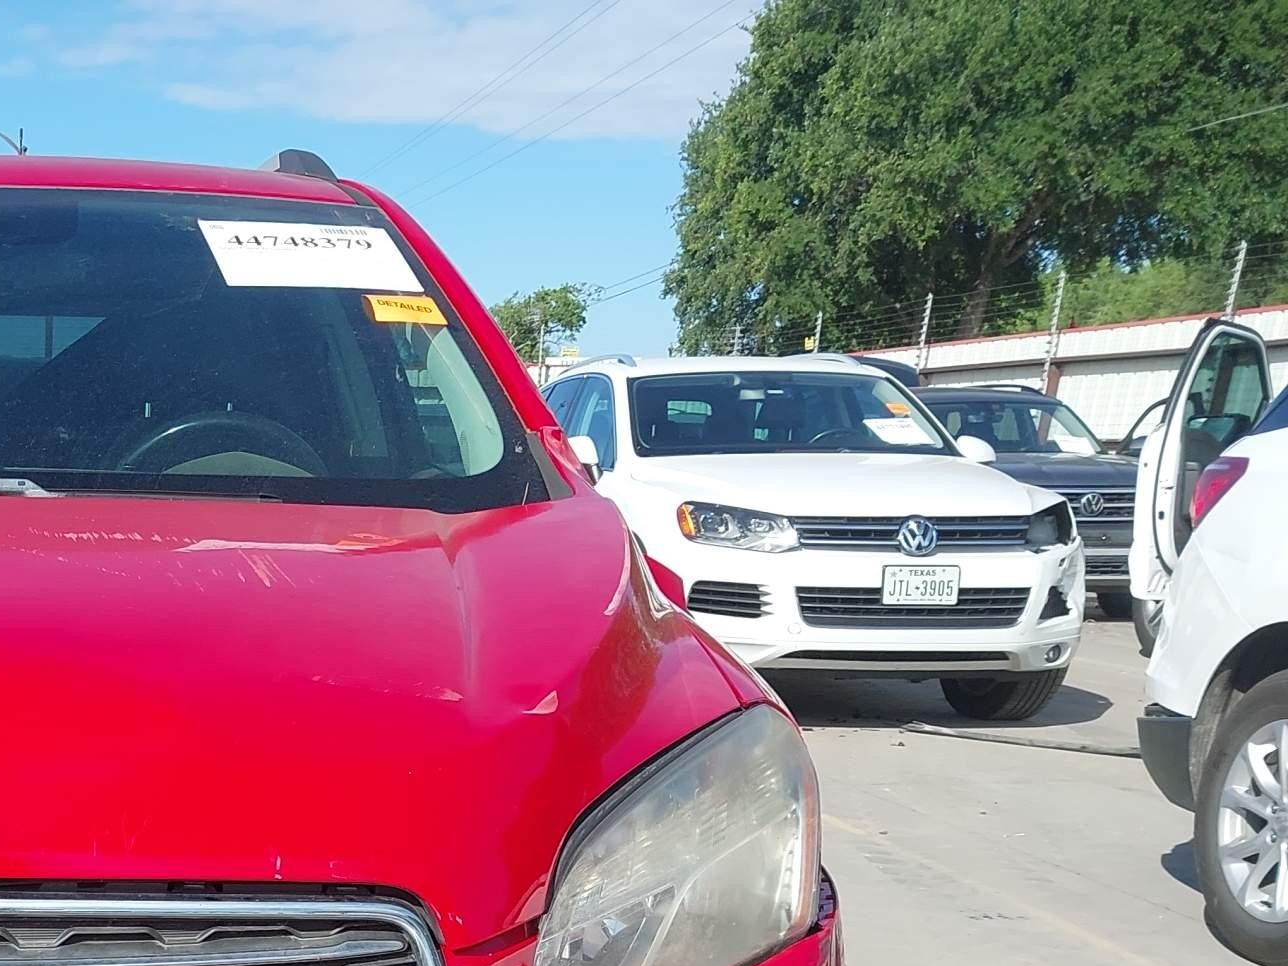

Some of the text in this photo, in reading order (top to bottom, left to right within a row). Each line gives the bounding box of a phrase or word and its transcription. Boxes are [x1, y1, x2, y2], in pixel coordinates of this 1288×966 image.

[227, 234, 373, 250] 44748379
[376, 299, 432, 314] DETAILED
[908, 569, 937, 577] TEXAS
